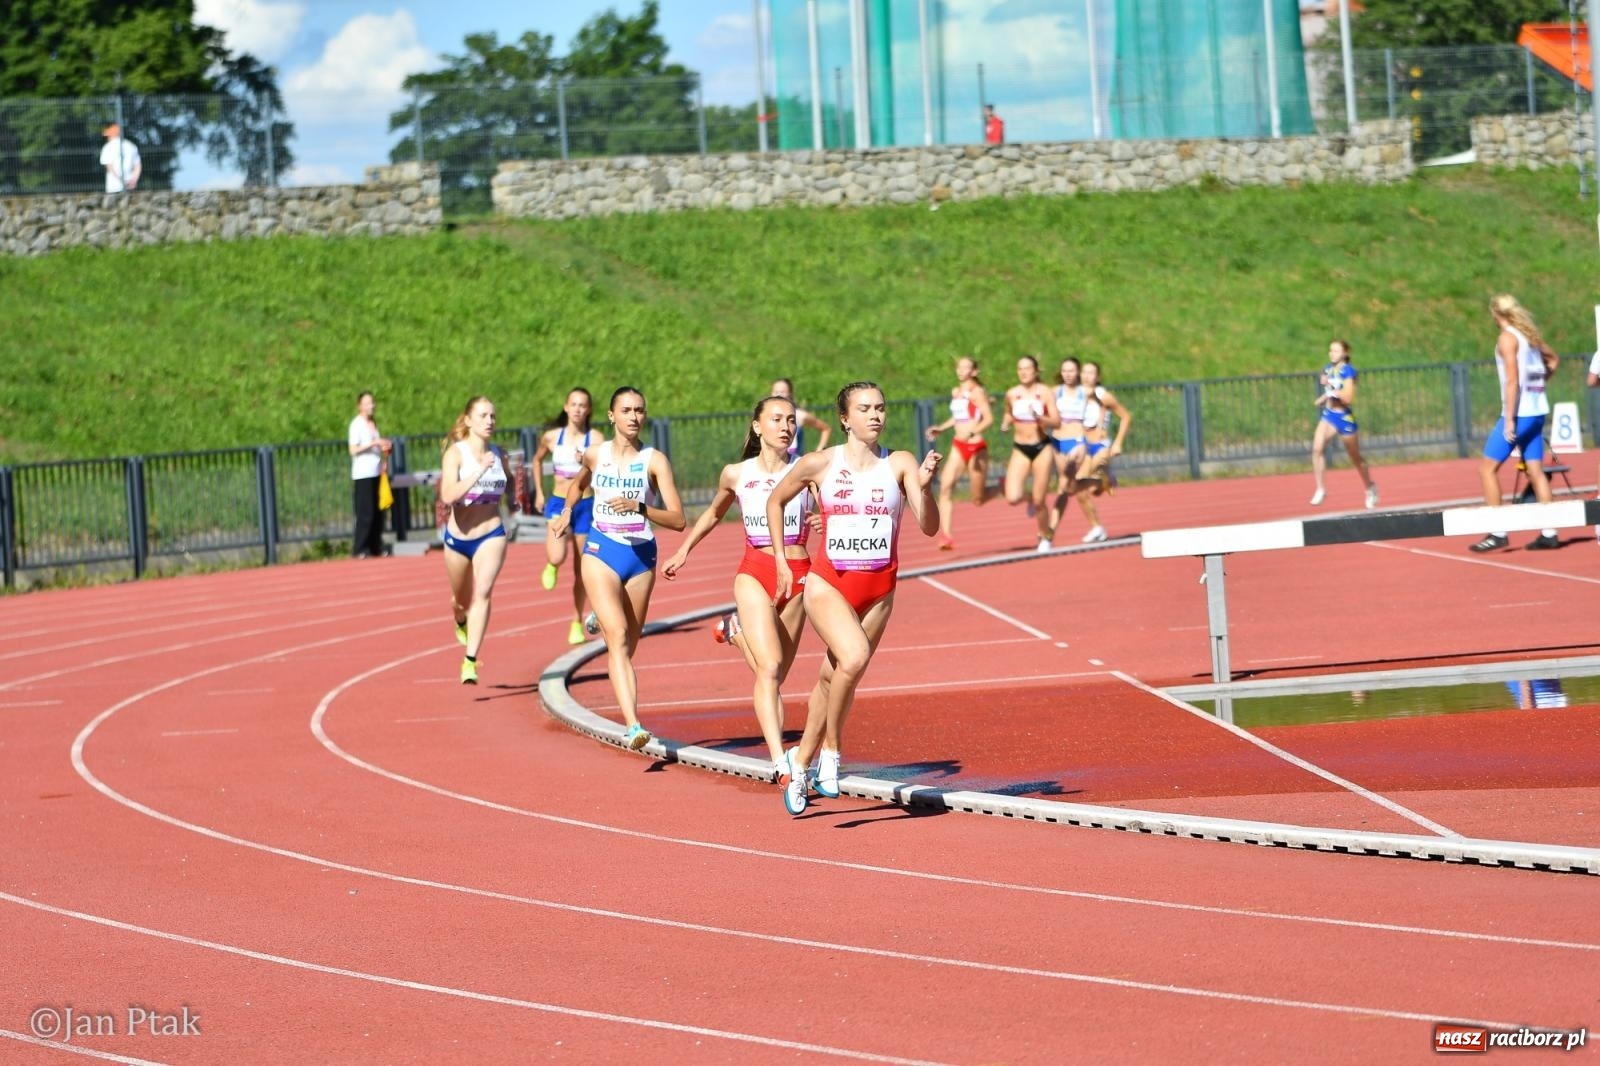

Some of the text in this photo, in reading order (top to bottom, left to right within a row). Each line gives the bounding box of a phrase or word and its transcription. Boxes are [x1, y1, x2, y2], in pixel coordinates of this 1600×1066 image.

[1558, 414, 1572, 440] 8
[622, 491, 640, 500] 107
[871, 518, 879, 529] 7
[829, 538, 888, 553] PAJĘCKA
